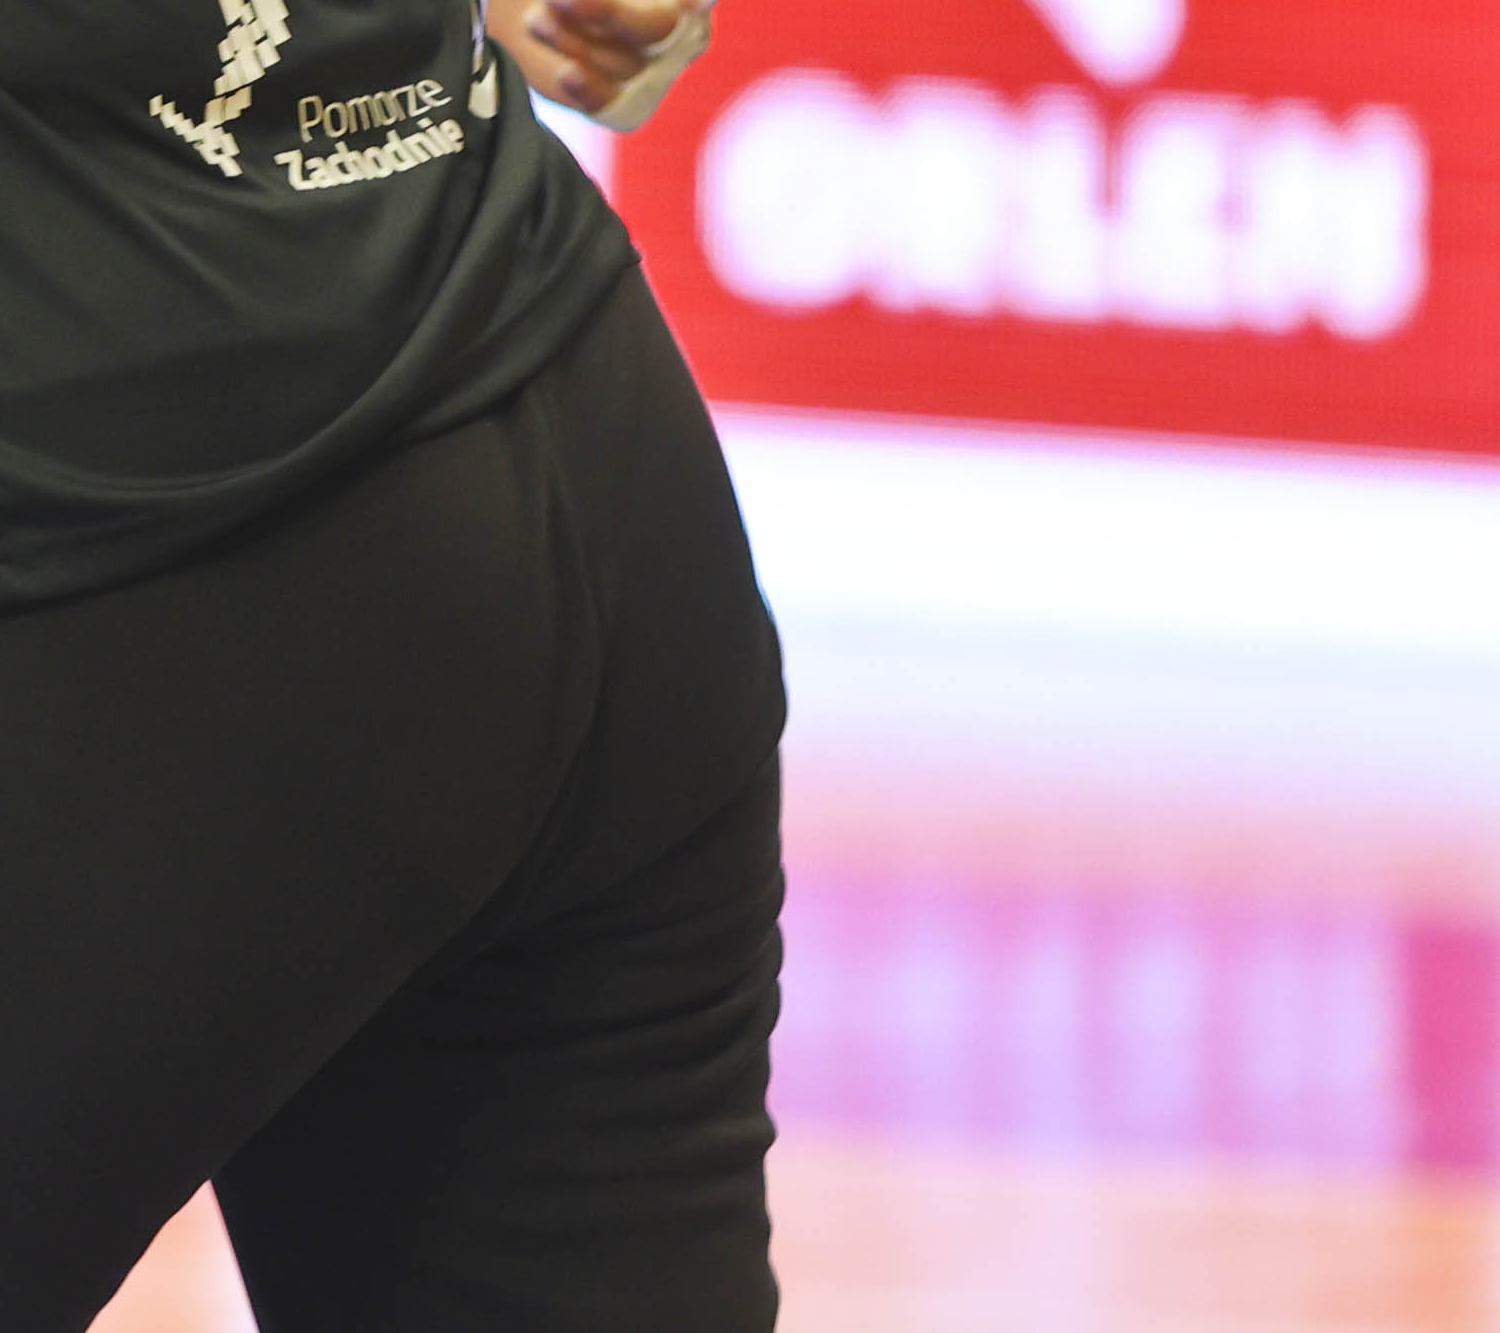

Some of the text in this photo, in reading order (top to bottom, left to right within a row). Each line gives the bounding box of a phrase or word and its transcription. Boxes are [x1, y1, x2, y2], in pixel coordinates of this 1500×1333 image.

[297, 78, 453, 143] Pomorze
[273, 116, 466, 191] Zachodnie
[695, 66, 1432, 341] ORLEN
